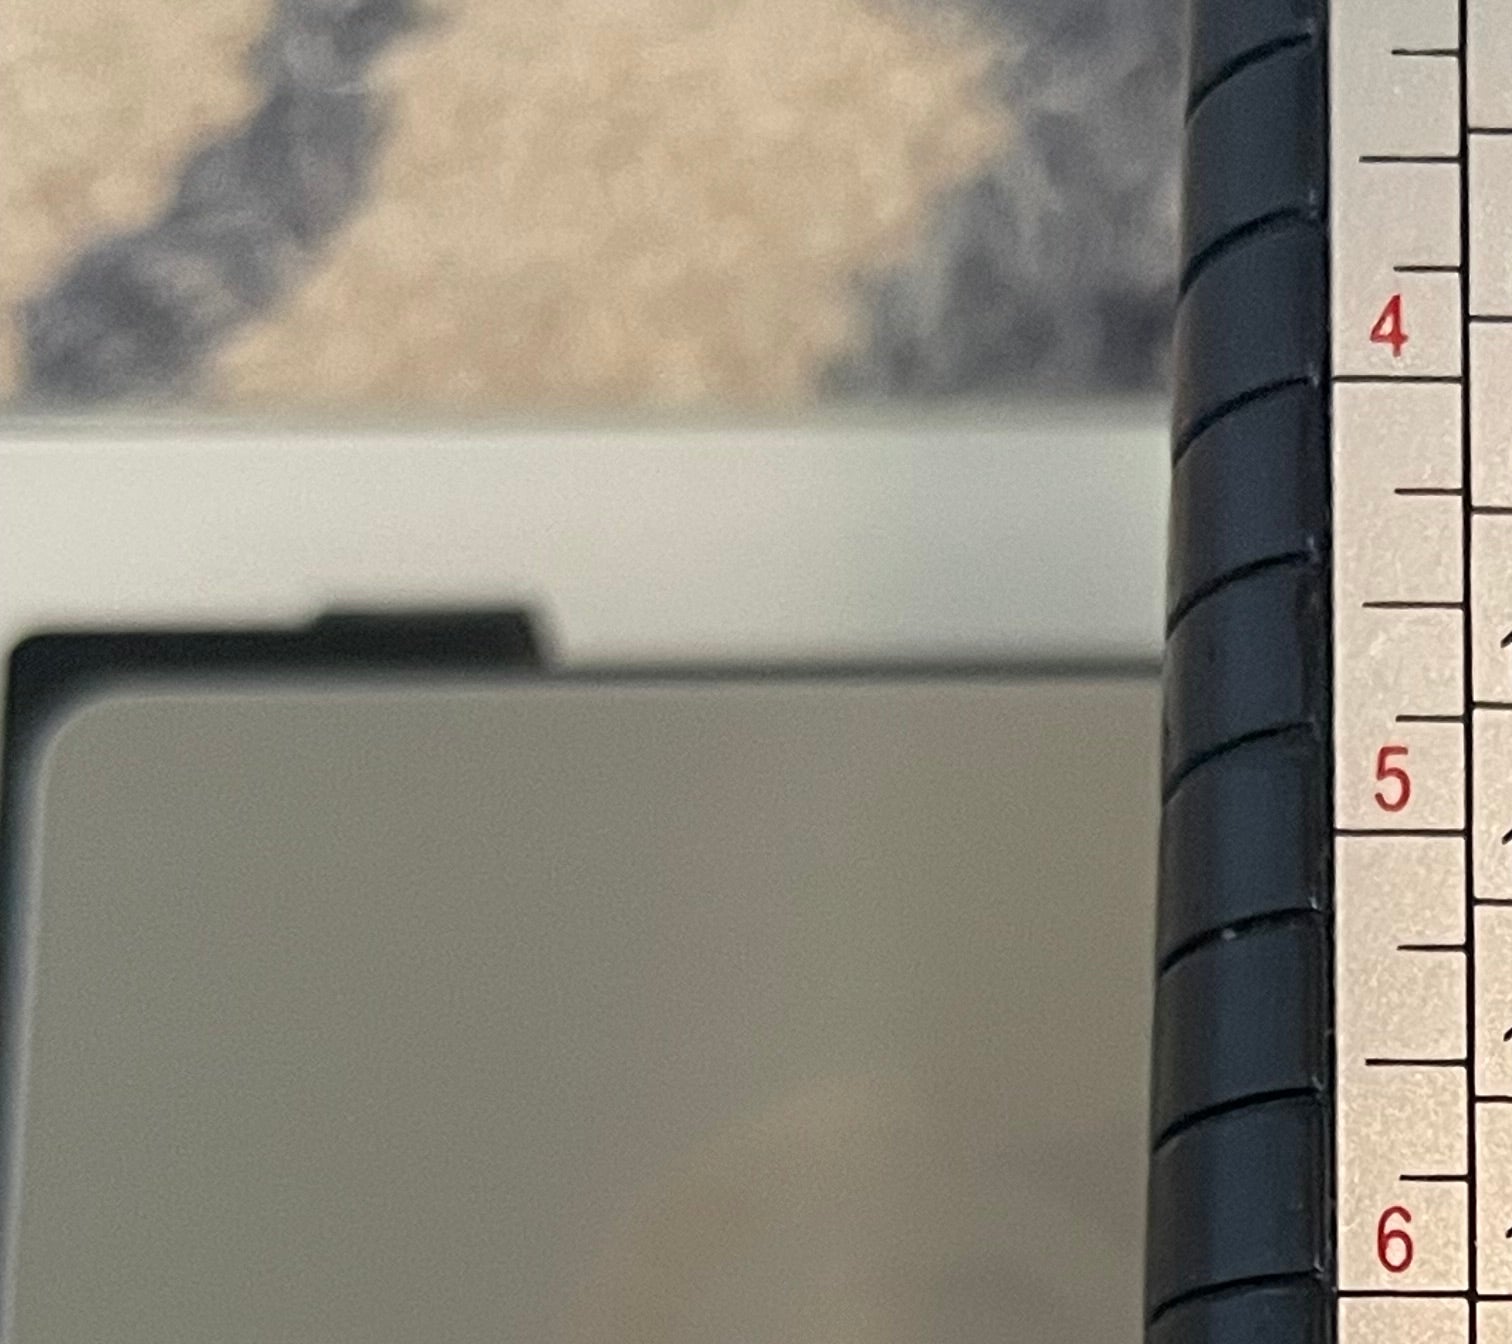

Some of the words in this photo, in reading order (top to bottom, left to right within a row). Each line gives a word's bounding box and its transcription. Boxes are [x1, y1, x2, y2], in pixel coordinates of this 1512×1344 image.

[1369, 293, 1409, 358] 4
[1374, 745, 1411, 813] 5
[1376, 1205, 1414, 1274] 6
